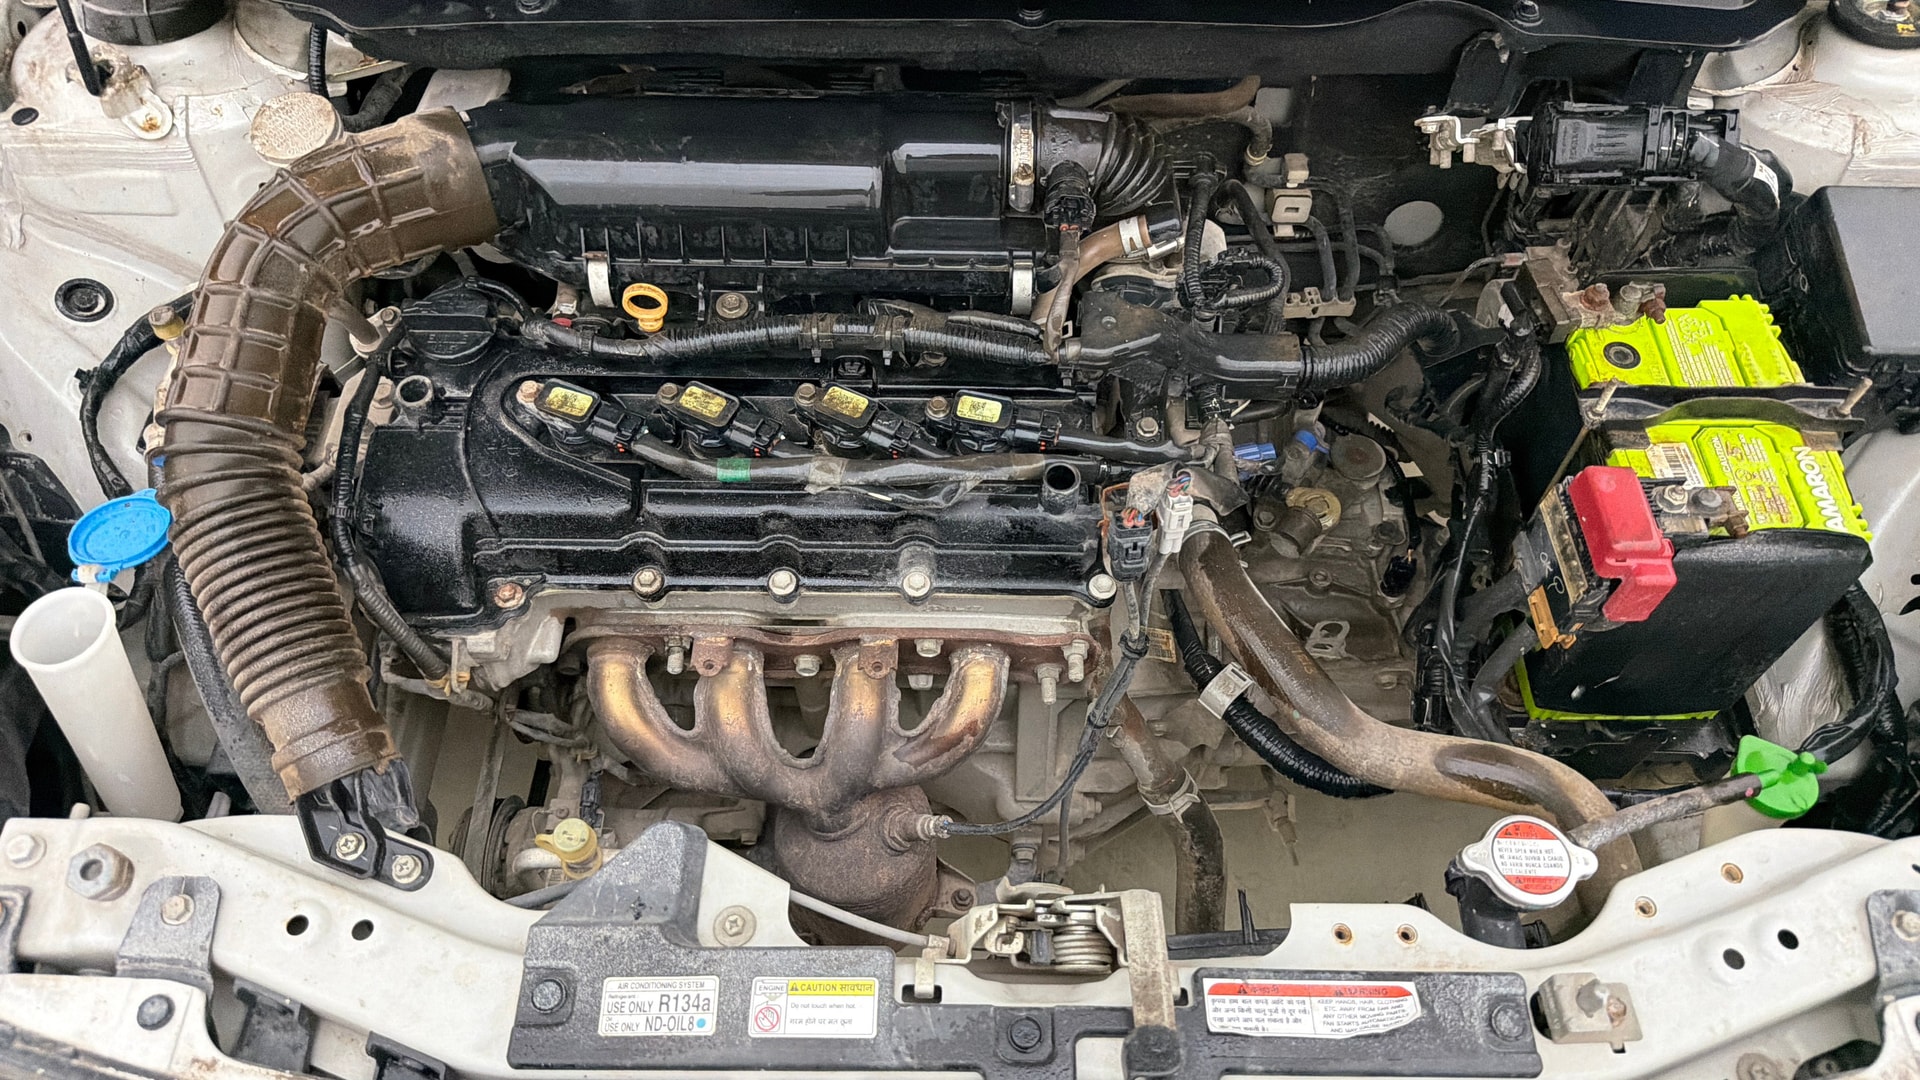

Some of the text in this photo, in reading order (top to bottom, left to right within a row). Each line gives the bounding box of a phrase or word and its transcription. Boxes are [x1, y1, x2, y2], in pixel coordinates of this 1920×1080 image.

[1792, 446, 1849, 533] AMARON
[630, 981, 678, 989] CONDITIONING
[679, 981, 705, 989] SYSTEM
[758, 984, 785, 992] ENGINE
[800, 983, 837, 992] CAUTION
[840, 983, 873, 992] सावधान
[606, 993, 711, 1014] USE ONLY R134a
[604, 1015, 694, 1032] USE ONLY ND-OIL8
